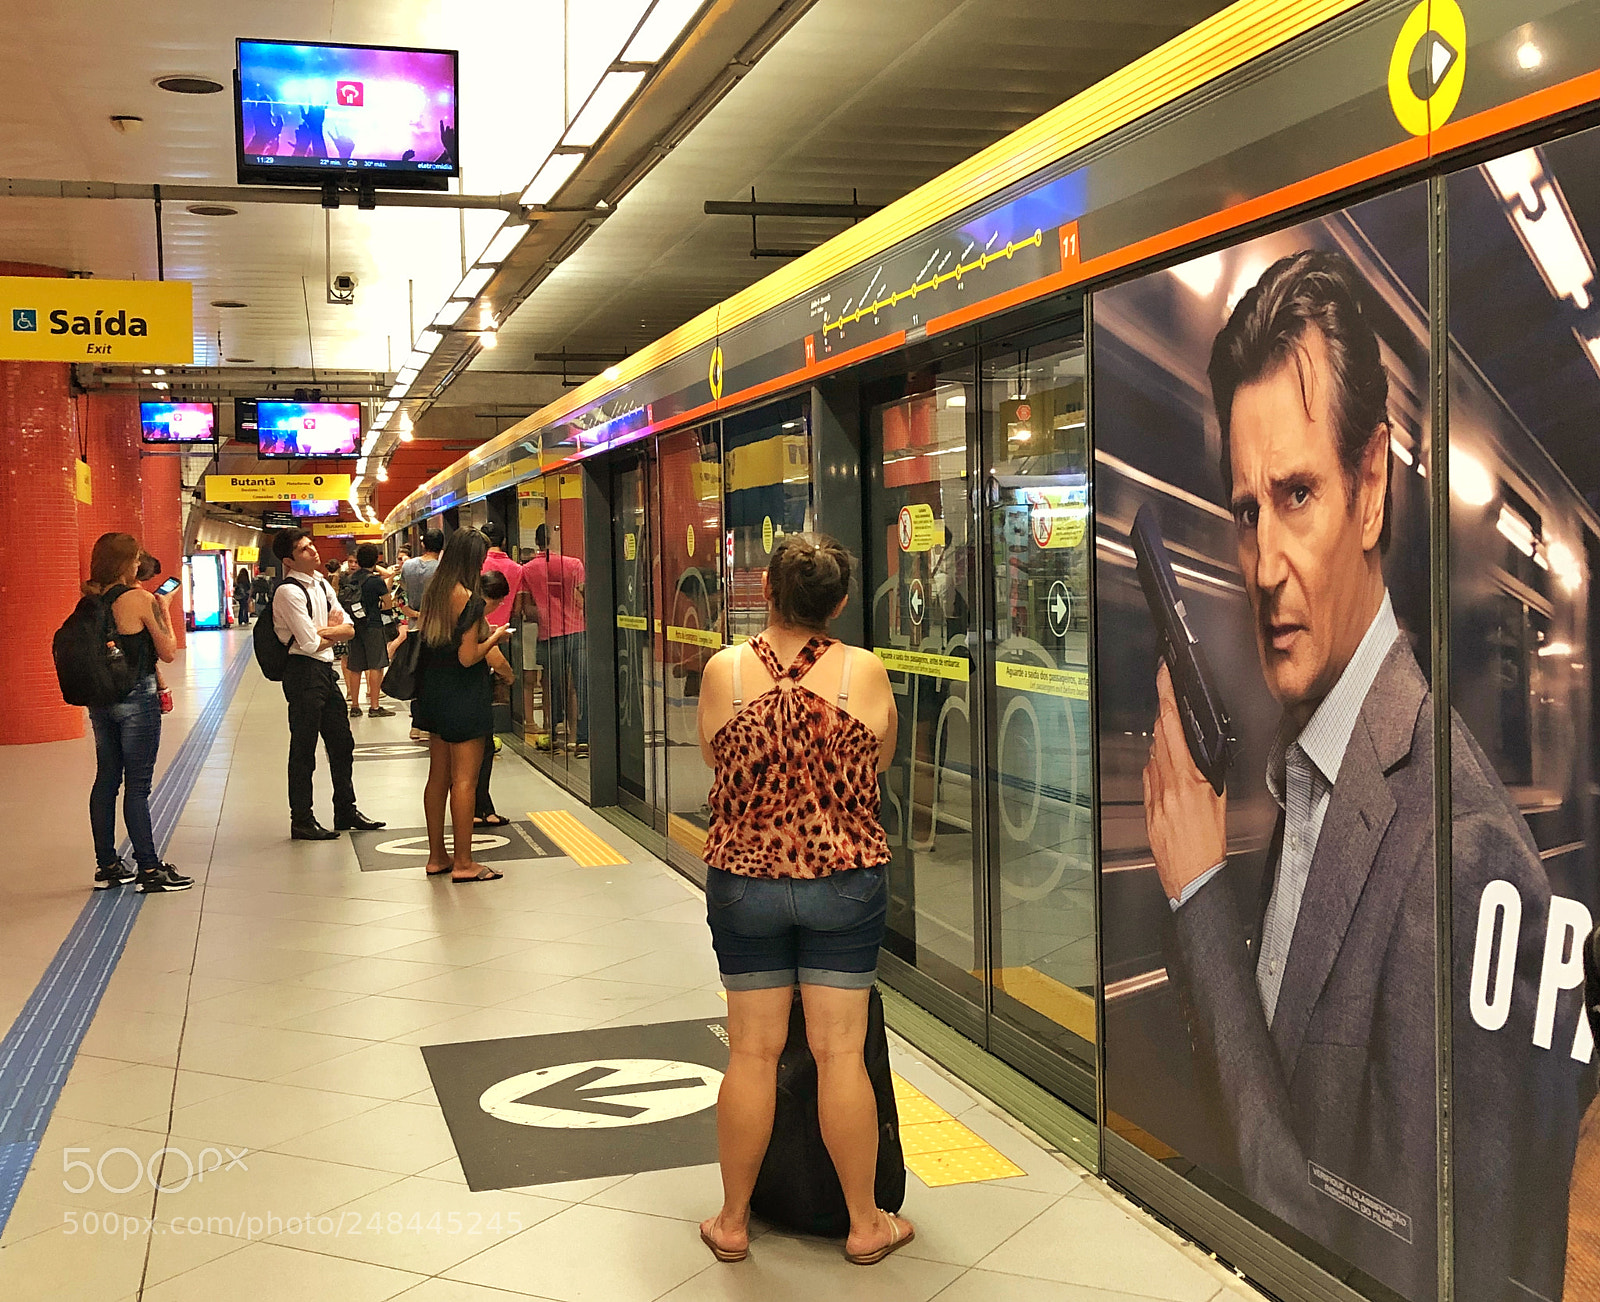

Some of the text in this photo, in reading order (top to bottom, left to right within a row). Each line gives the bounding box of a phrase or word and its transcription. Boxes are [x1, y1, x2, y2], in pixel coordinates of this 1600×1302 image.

[1062, 233, 1076, 258] 11
[49, 309, 149, 336] Saída
[86, 343, 113, 355] Exit
[806, 343, 814, 359] 11
[230, 477, 276, 486] Butantã
[1470, 879, 1595, 1064] O P
[1312, 1166, 1407, 1227] VERIFIQUE A CLASSIFICAÇÃO
[1324, 1183, 1394, 1230] INDICATIVA DO FILME
